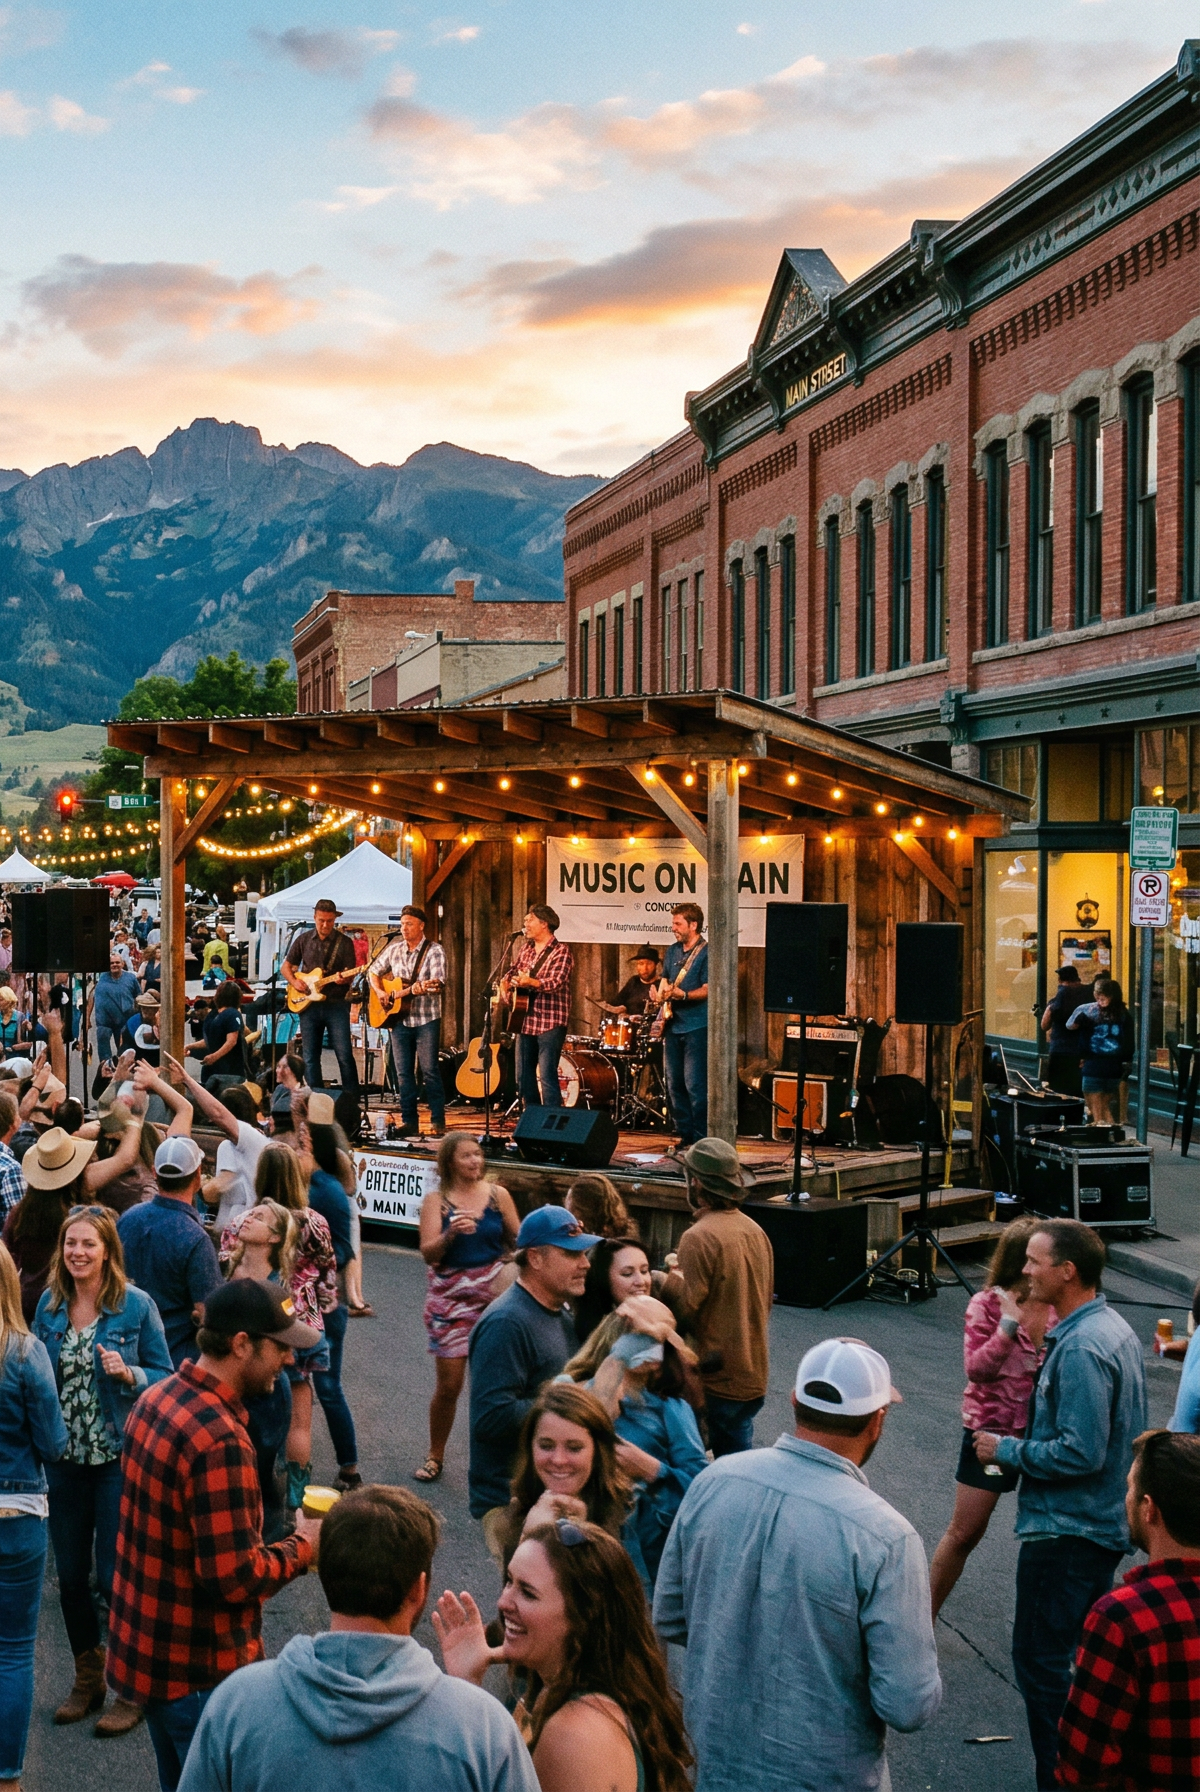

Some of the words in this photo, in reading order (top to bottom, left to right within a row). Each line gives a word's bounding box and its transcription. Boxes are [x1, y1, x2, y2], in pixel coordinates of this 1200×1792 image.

[559, 862, 645, 893] MUSIC
[654, 862, 696, 894] ON
[738, 862, 790, 894] AIN
[373, 1199, 406, 1216] MAIN
